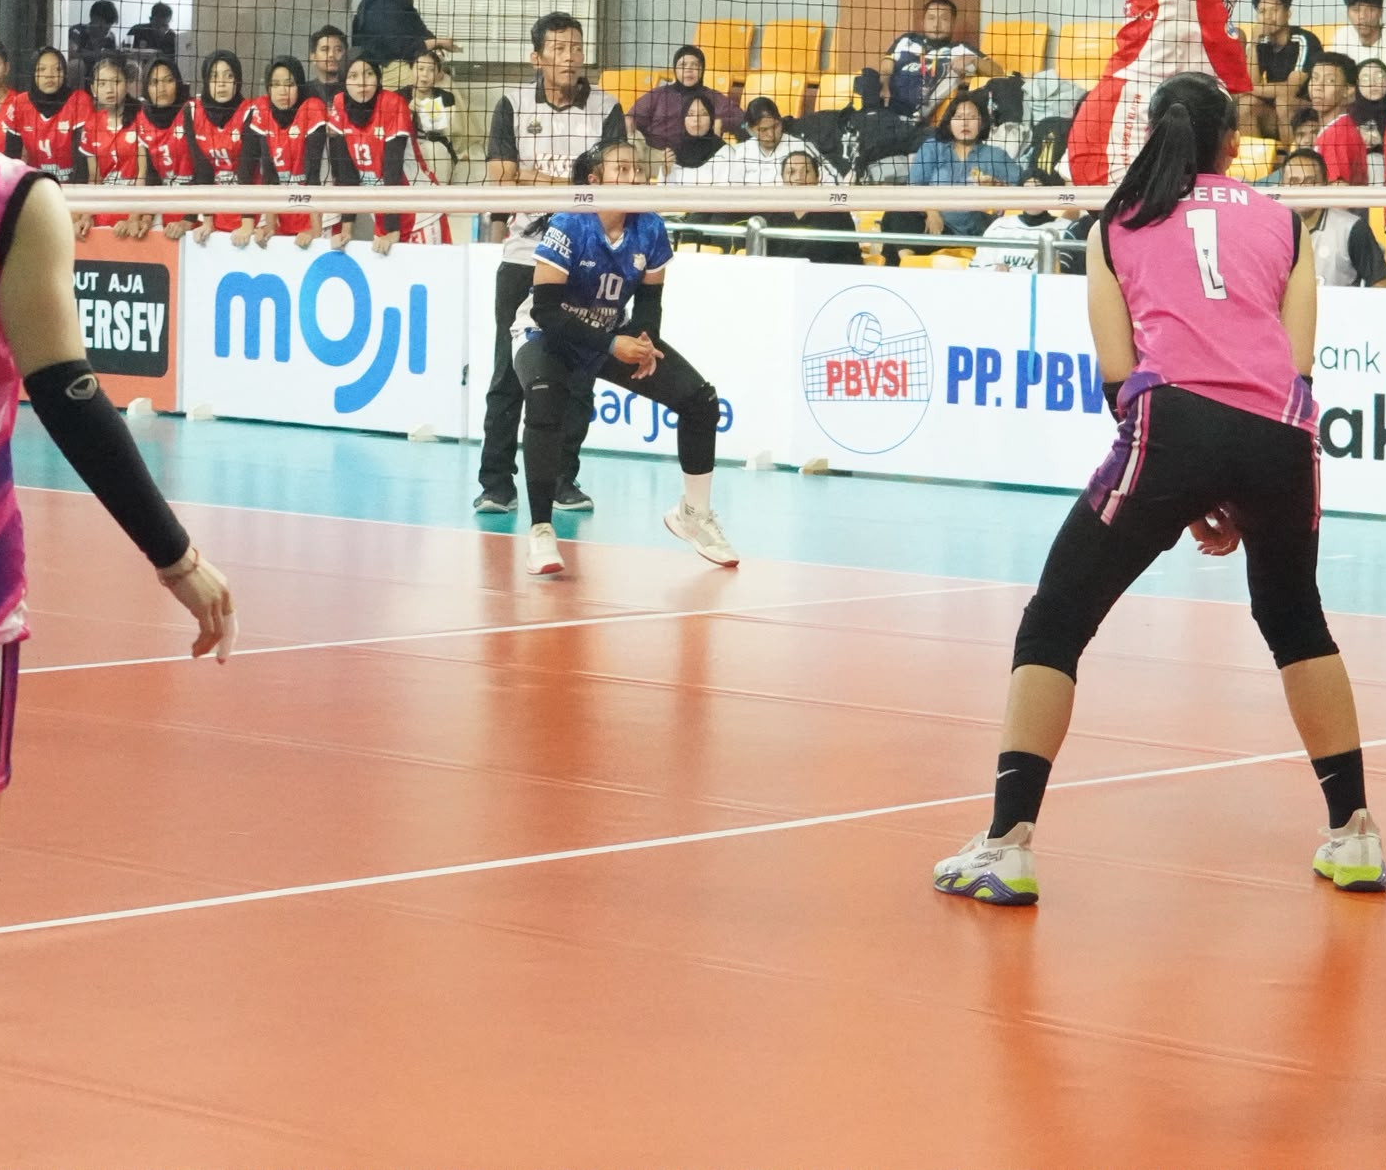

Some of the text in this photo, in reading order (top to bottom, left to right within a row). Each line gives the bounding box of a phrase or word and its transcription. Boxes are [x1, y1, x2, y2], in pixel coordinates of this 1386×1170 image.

[38, 138, 52, 159] 4
[158, 144, 172, 166] 3
[353, 143, 373, 166] 13
[288, 194, 312, 203] FIVB
[574, 193, 594, 202] FIVB
[829, 193, 848, 203] FIVB
[1186, 208, 1228, 300] 1
[108, 272, 145, 294] AJA
[596, 272, 624, 301] 10
[1314, 341, 1382, 374] ank
[825, 359, 908, 398] PBVSI
[946, 345, 1107, 415] PP. PBV
